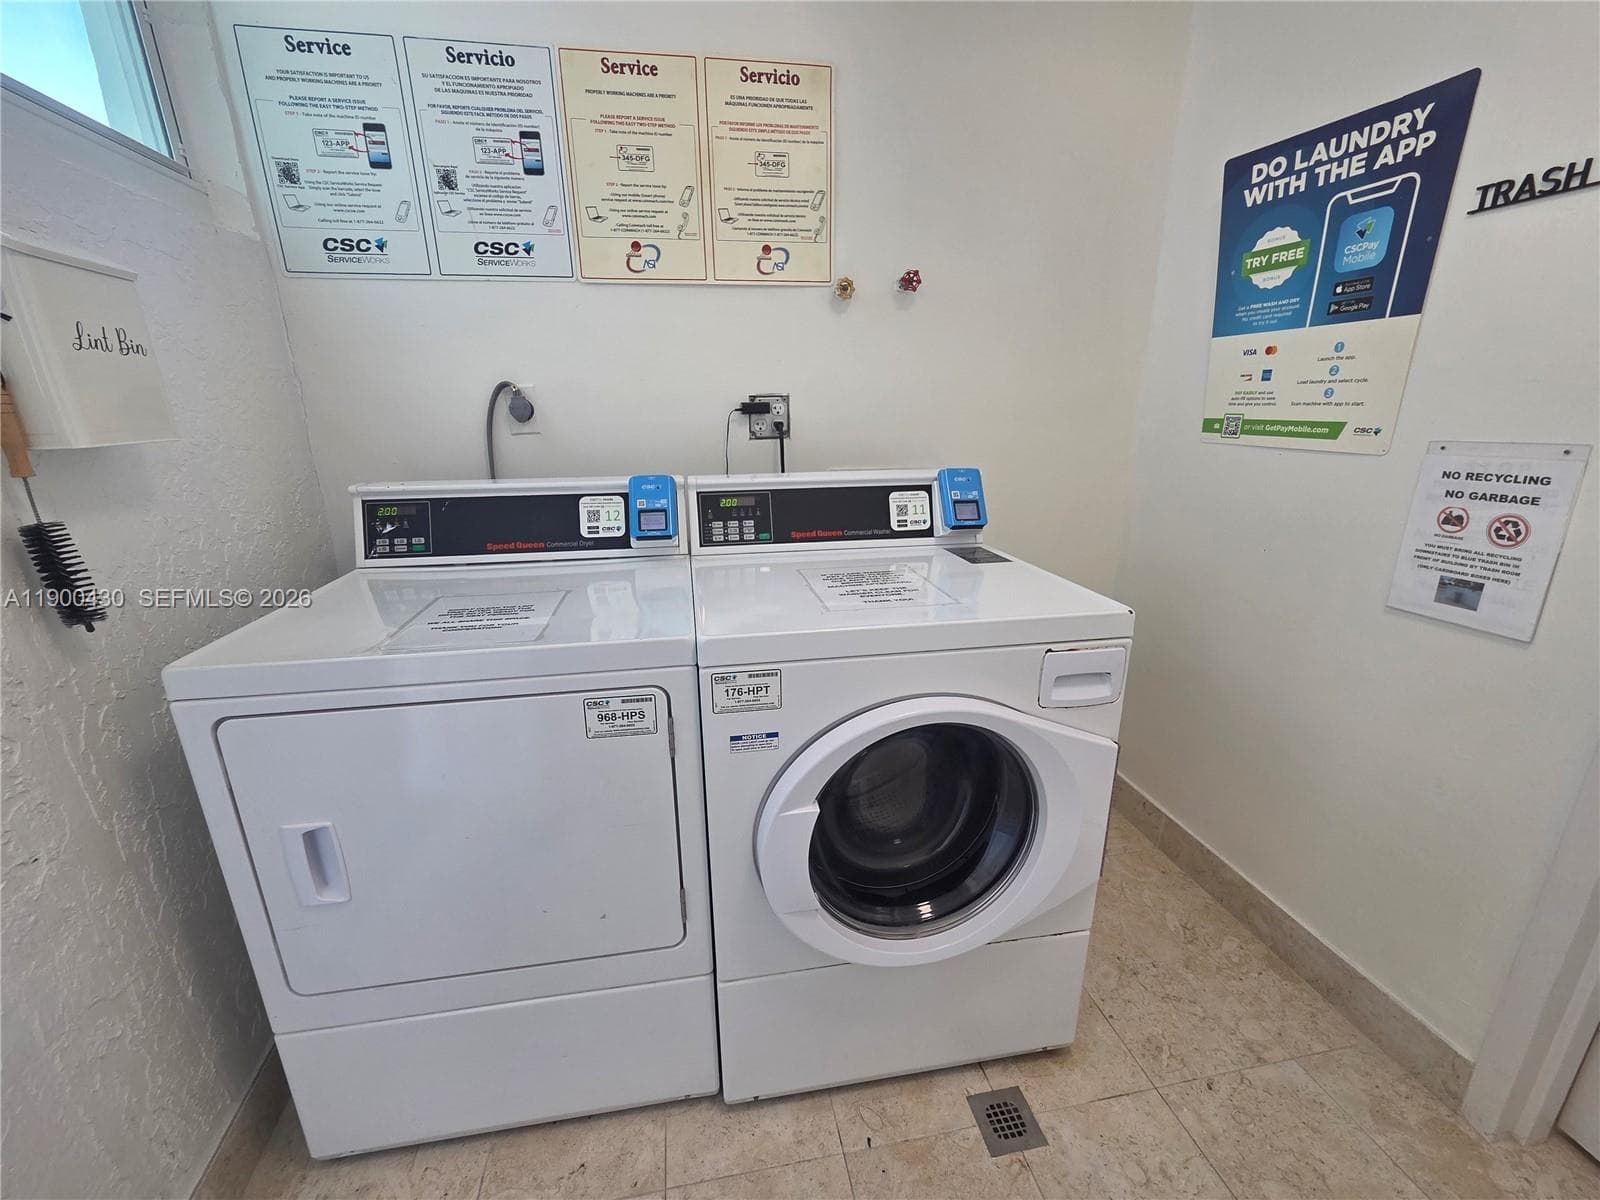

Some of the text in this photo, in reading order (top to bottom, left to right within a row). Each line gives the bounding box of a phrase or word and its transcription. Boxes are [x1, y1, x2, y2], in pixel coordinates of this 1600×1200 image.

[284, 34, 352, 56] Service
[445, 46, 516, 67] Servicio
[600, 57, 658, 76] Service
[740, 66, 800, 86] Servicio
[1251, 102, 1436, 184] DO LAUNDRY
[1244, 130, 1437, 208] WITH THE APP
[1476, 158, 1594, 210] TRASH
[322, 237, 372, 252] CSC
[474, 241, 520, 256] CSC
[1344, 240, 1380, 254] CSCPay
[1245, 247, 1304, 269] TRY FREE
[1342, 252, 1376, 266] Mobile
[72, 320, 147, 357] Lint Bin
[1265, 424, 1329, 434] GetPayMobile.com
[1442, 471, 1552, 486] NO RECYCLING
[1445, 489, 1541, 506] NO GARBAGE
[605, 510, 620, 522] 12
[912, 504, 926, 515] 11
[791, 530, 816, 539] Speed
[486, 542, 514, 551] Speed
[1415, 548, 1450, 558] DOWNSTAIRS
[1478, 558, 1498, 566] TRASH
[1486, 552, 1523, 562] RECYCLING
[1434, 566, 1469, 577] CARDBOARD
[1471, 572, 1490, 581] BOXES
[1440, 559, 1468, 568] BUILDING
[1480, 565, 1500, 574] TRASH
[1502, 569, 1520, 577] ROOM
[724, 685, 770, 697] 176-HPT
[597, 710, 646, 722] 968-HPS
